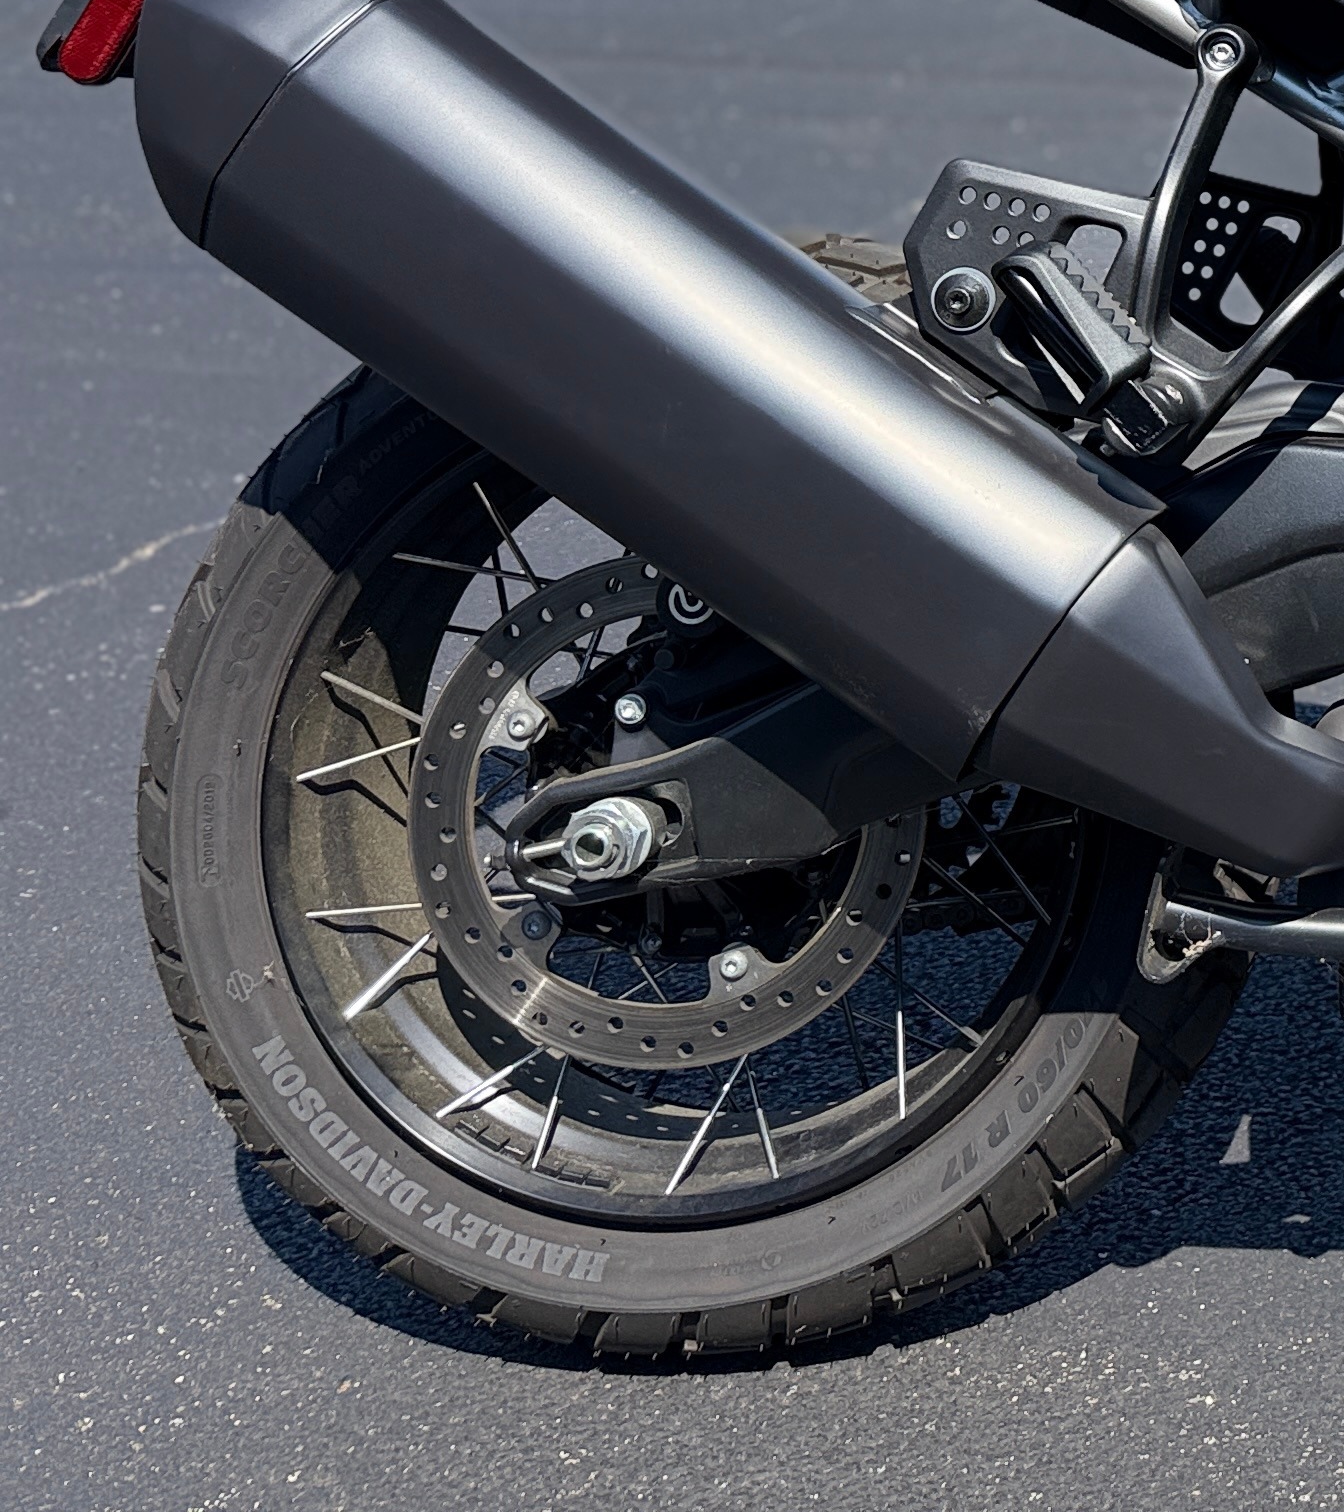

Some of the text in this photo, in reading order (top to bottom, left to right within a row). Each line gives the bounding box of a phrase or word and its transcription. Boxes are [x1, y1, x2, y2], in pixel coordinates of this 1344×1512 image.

[359, 411, 438, 472] ADVENT
[252, 1034, 611, 1283] HARLEY-DAVIDSON
[941, 1140, 979, 1193] 17
